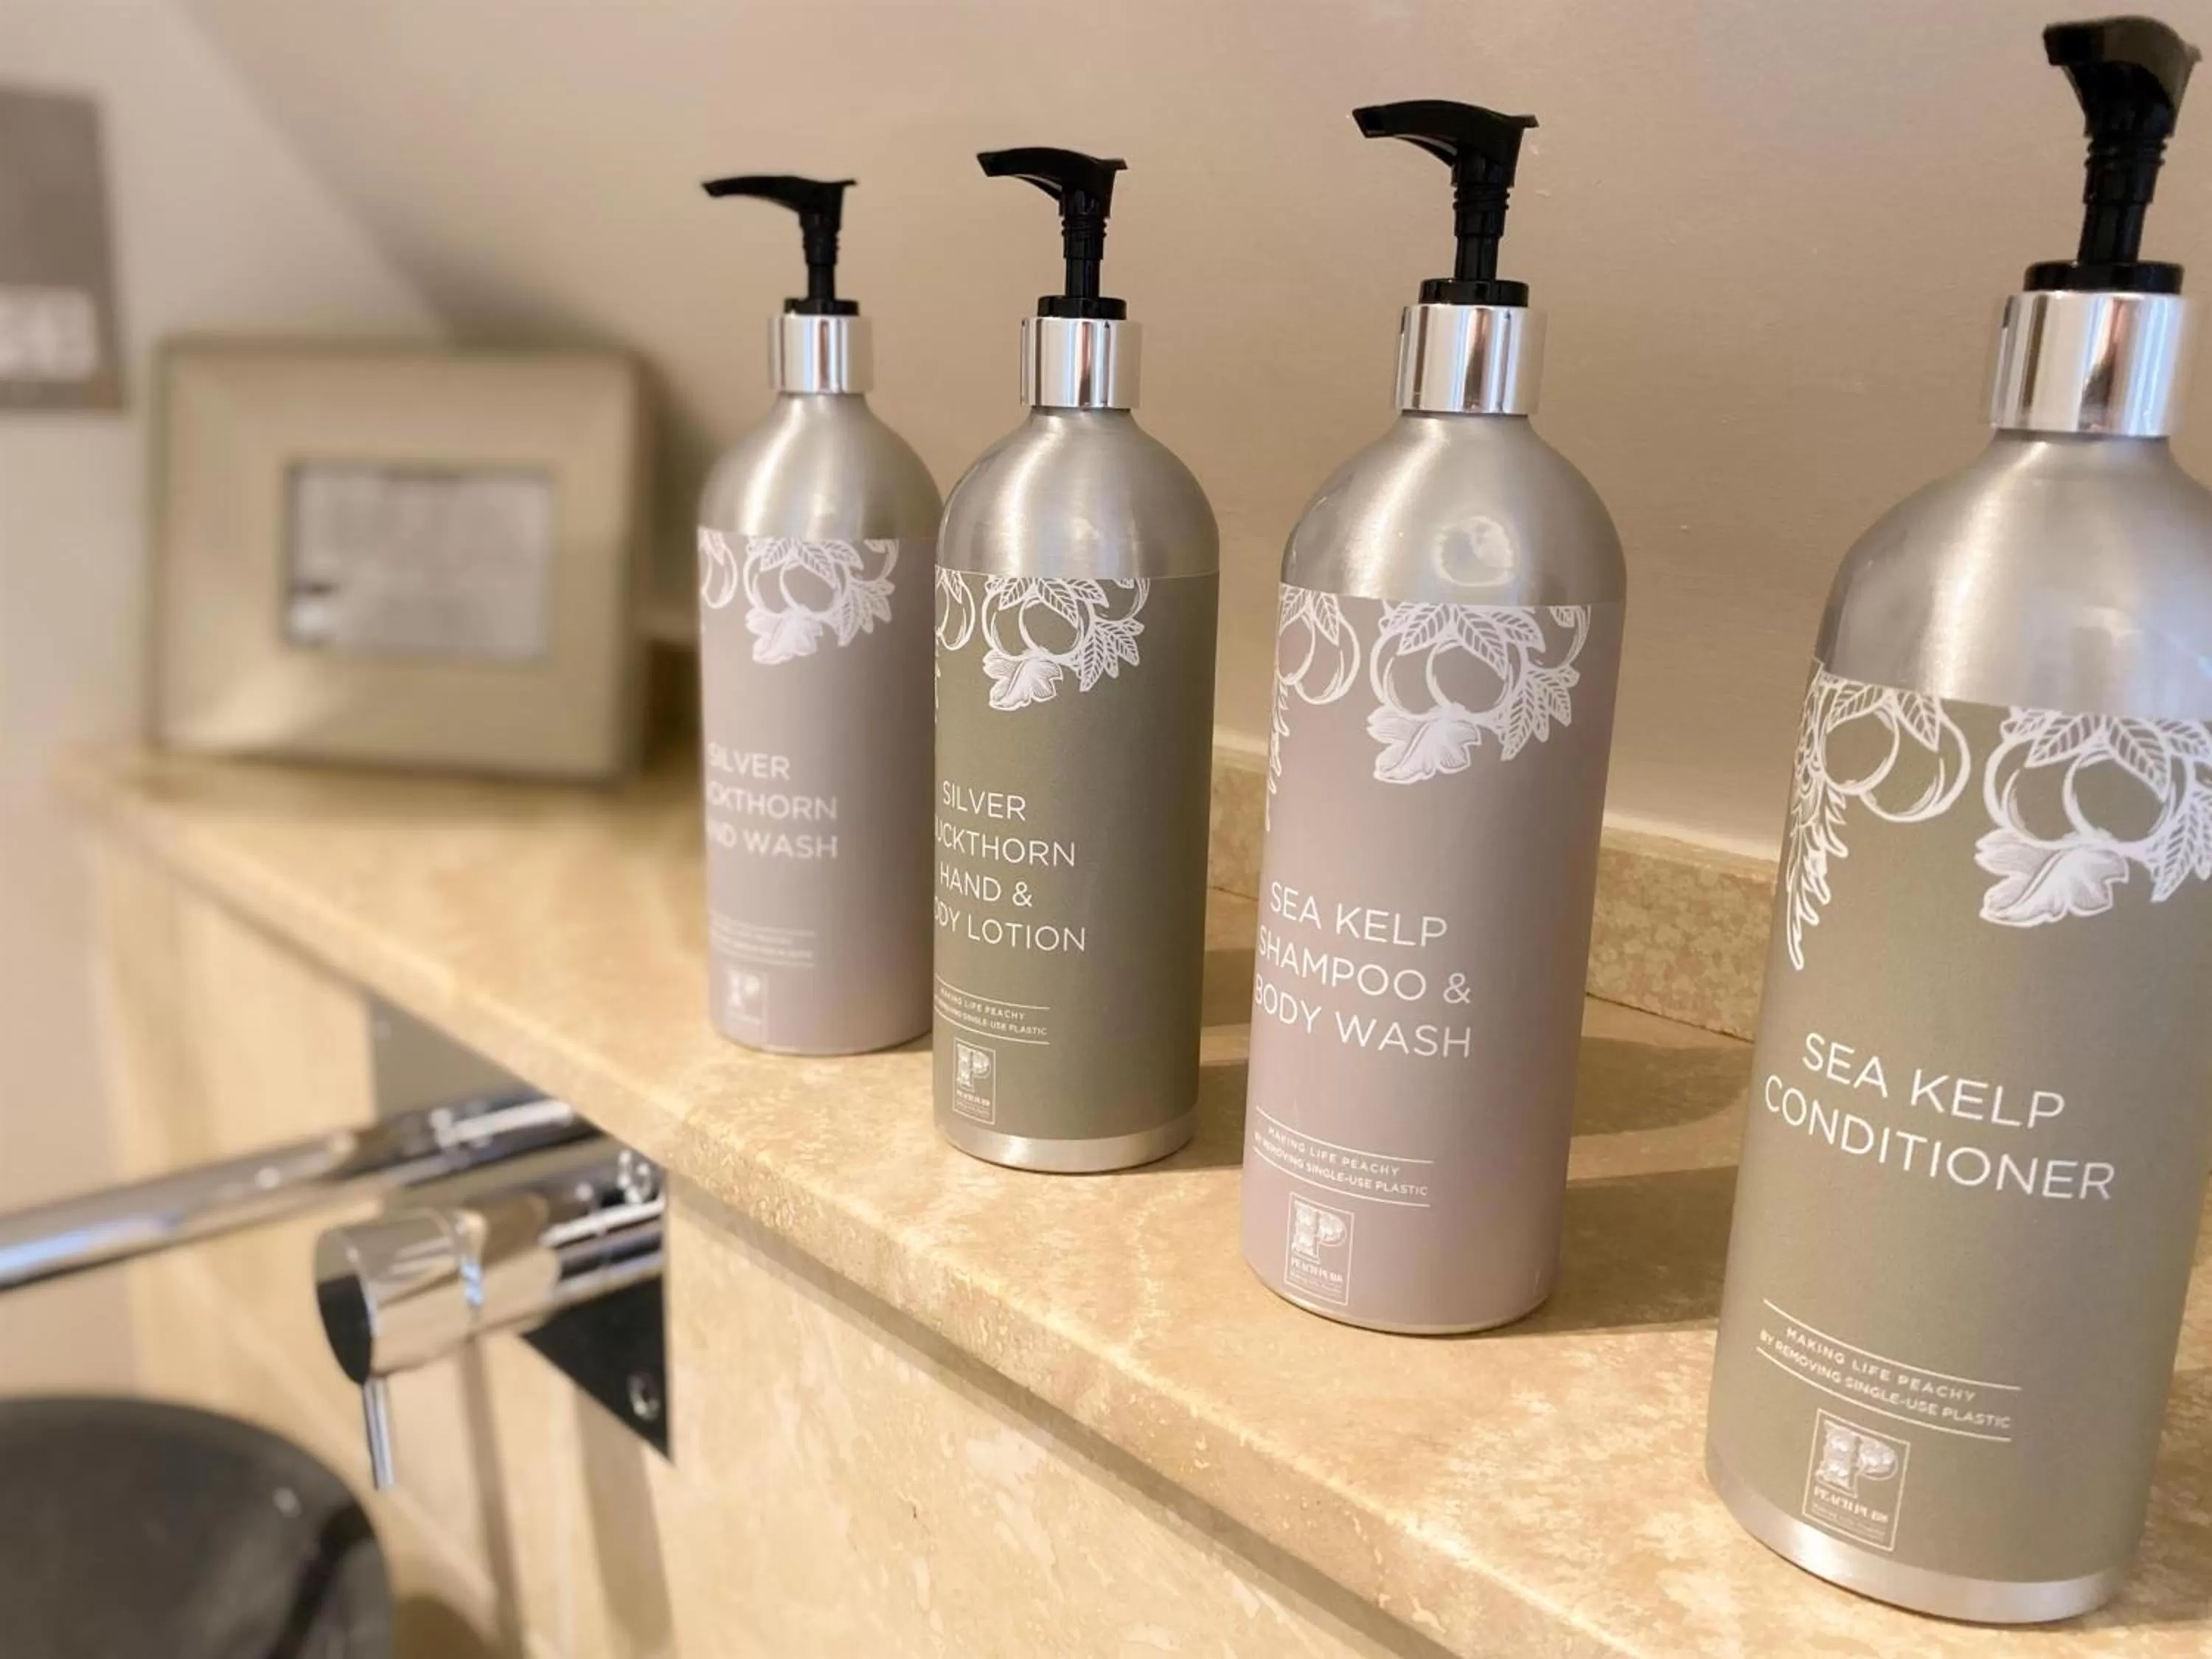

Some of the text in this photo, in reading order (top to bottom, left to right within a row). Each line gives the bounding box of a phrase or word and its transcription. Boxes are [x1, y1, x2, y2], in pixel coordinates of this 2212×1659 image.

[943, 780, 1026, 821] SILVER
[742, 829, 838, 859] WASH
[935, 814, 1074, 866] UCKTHORN
[940, 861, 1032, 907] HAND &
[968, 914, 1085, 951] LOTION
[1270, 881, 1447, 947] SEA KELP
[1259, 925, 1471, 1004] SHAMPOO &
[1008, 1023, 1048, 1036] PLASTIC
[1255, 973, 1471, 1058] BODY WASH
[1802, 1032, 2065, 1129] SEA KELP
[1268, 1126, 1400, 1177] MAKING LIFE PEACHY
[1764, 1074, 2115, 1200] CONDITIONER
[1376, 1180, 1428, 1196] PLASTIC
[1759, 1329, 2011, 1428] BY REMOVING SINGLE-USE PLASTIC
[1786, 1326, 1976, 1401] MAKING LIFE PEACHY
